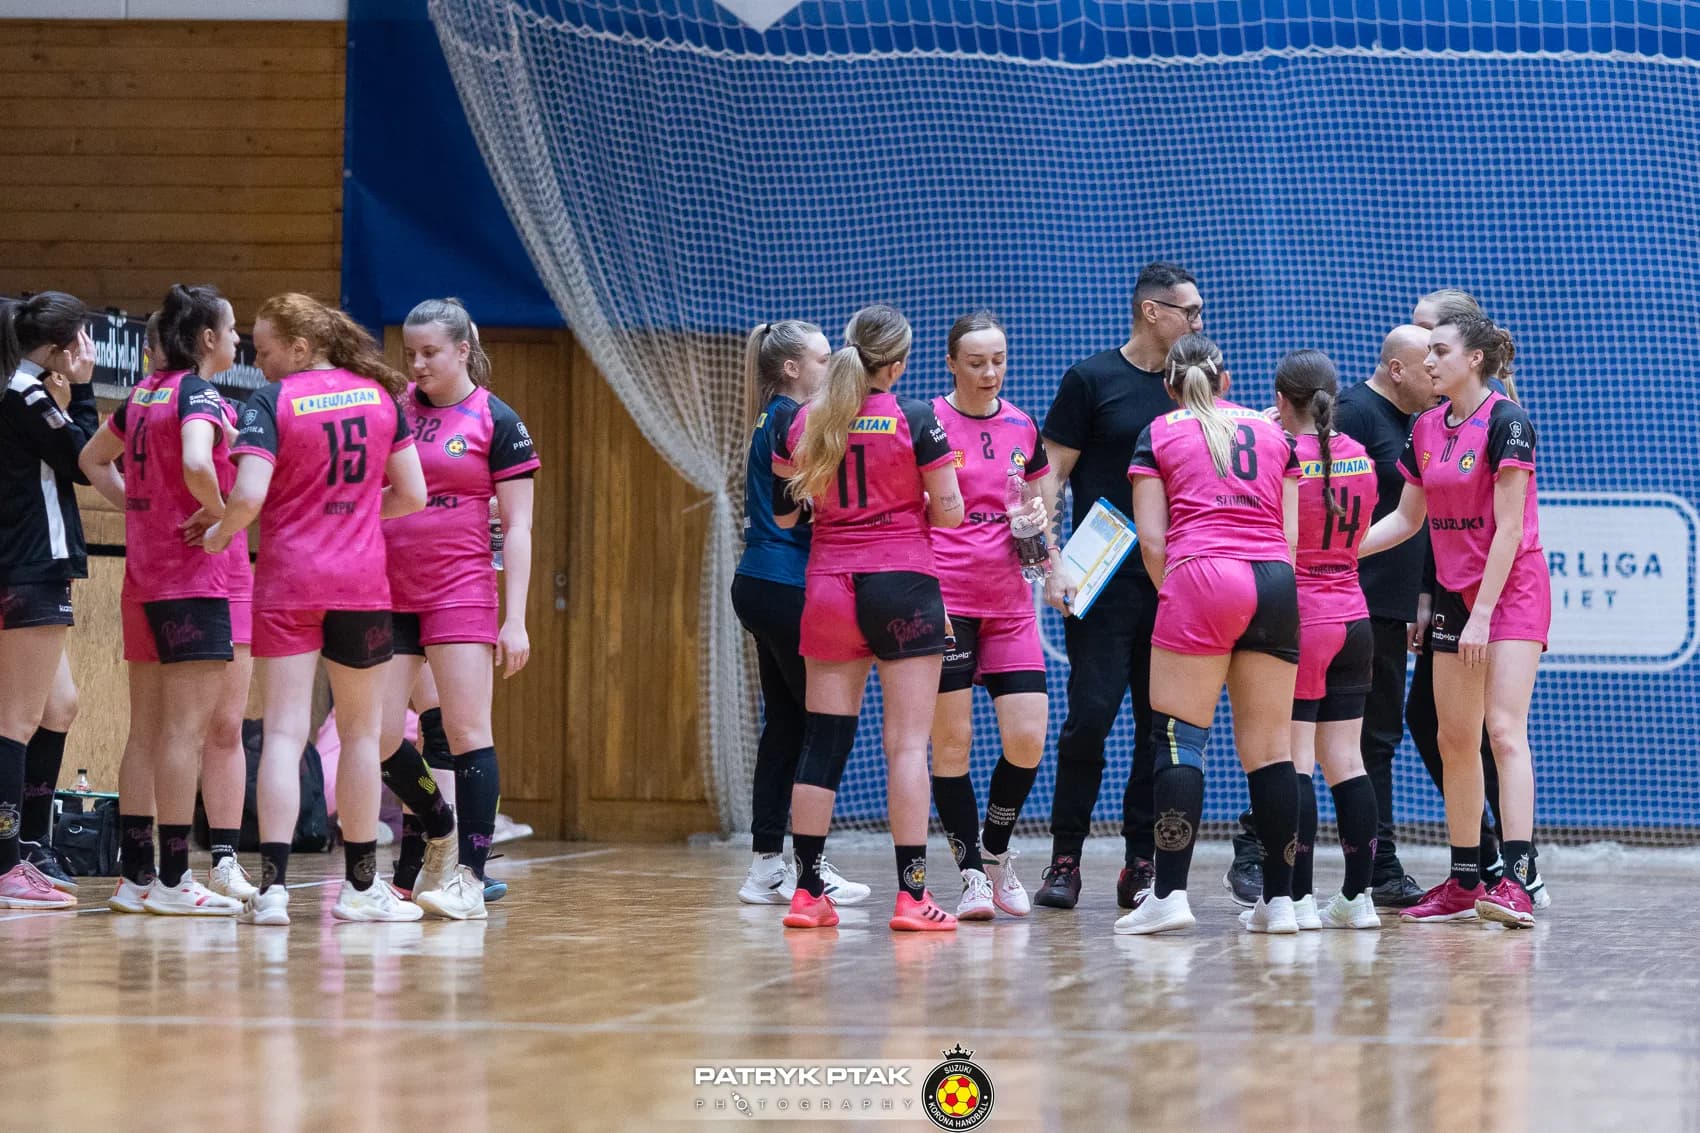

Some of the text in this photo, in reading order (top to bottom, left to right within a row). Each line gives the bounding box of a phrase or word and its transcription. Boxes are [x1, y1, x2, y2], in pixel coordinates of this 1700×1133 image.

[316, 391, 375, 410] LEWIATAN
[412, 415, 442, 443] 32
[132, 417, 147, 481] 4
[322, 415, 368, 487] 15
[980, 431, 996, 460] 2
[1231, 424, 1258, 481] 8
[837, 443, 868, 509] 11
[1322, 486, 1361, 551] 14
[1431, 516, 1485, 530] SUZUKI
